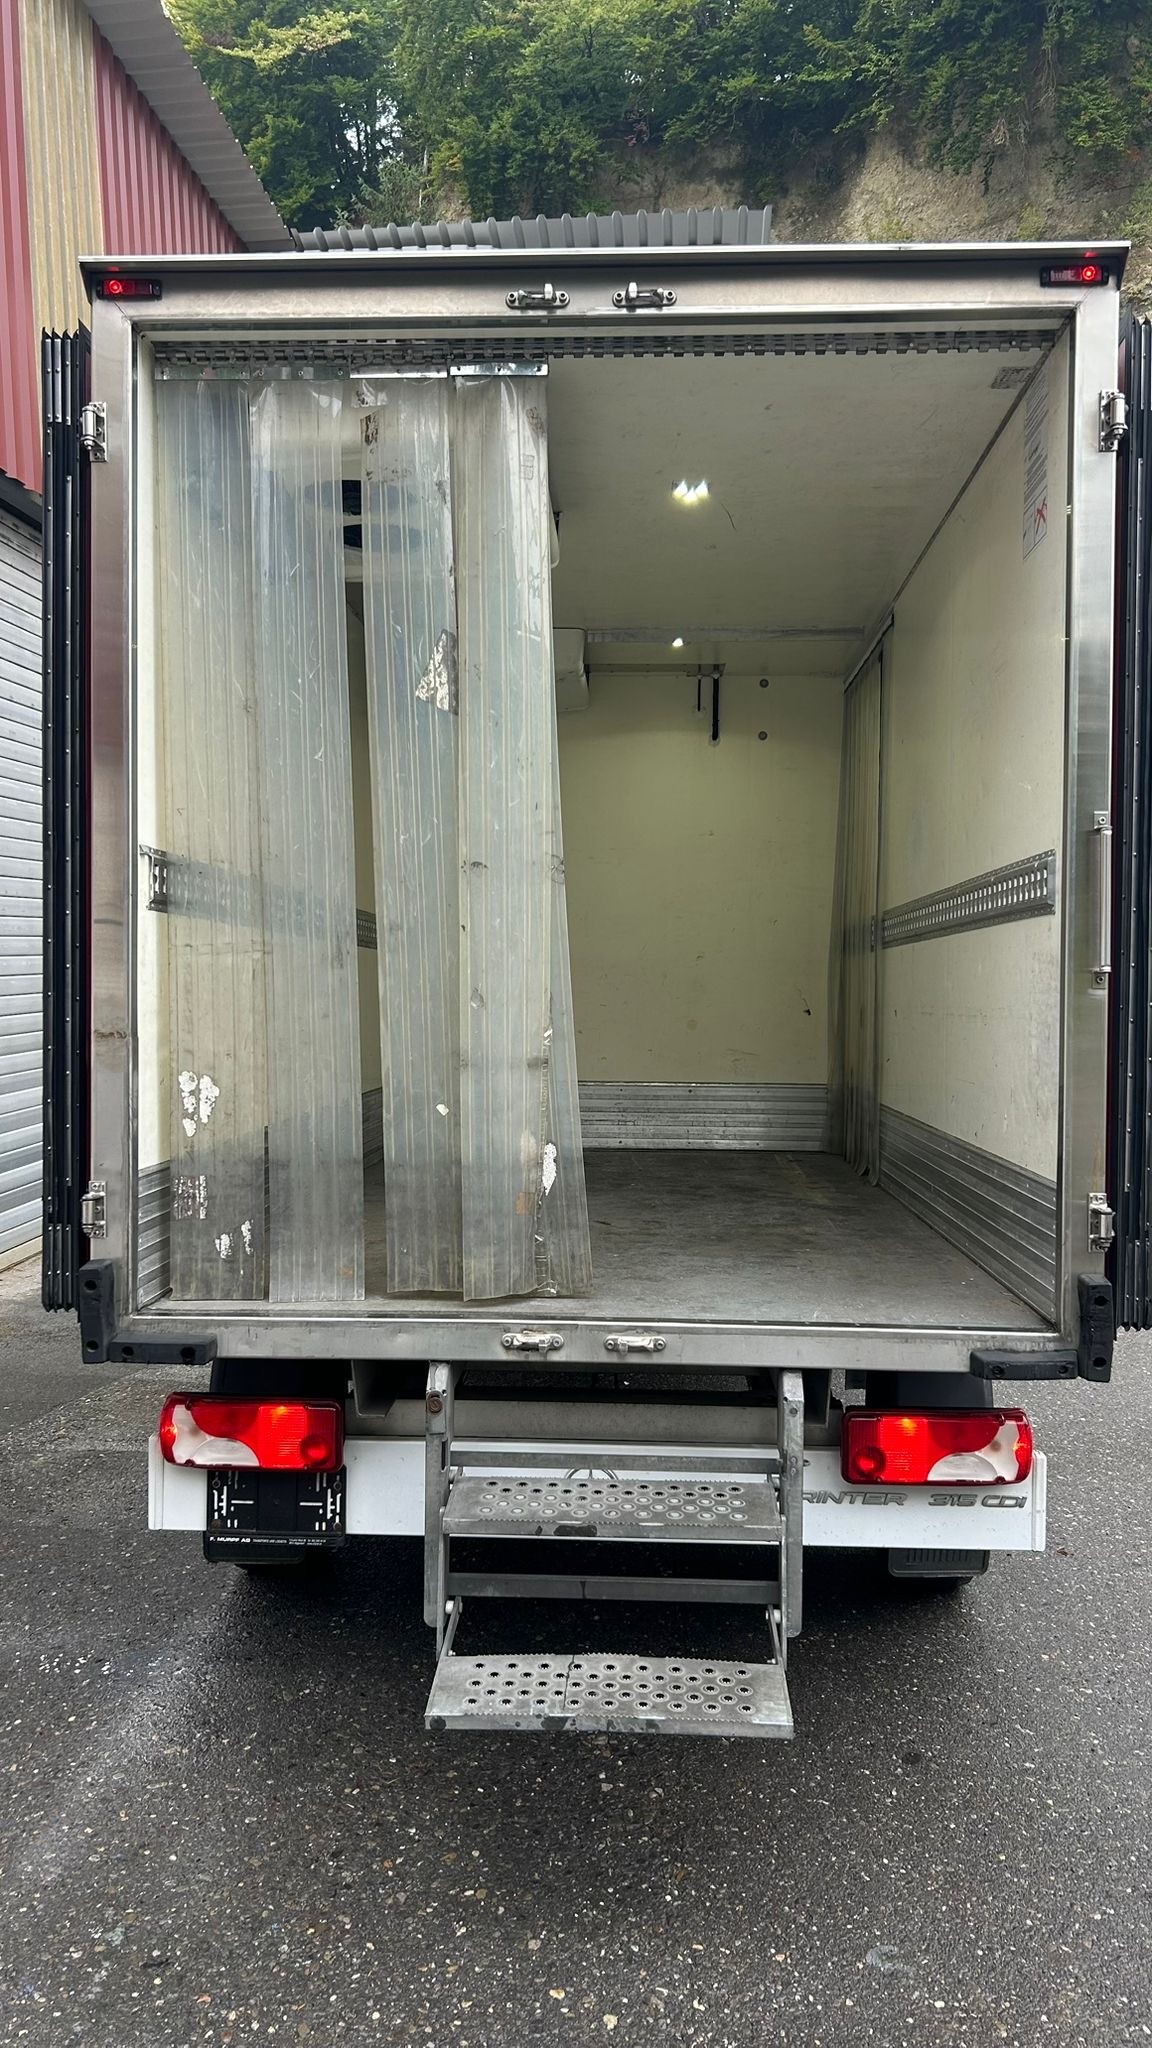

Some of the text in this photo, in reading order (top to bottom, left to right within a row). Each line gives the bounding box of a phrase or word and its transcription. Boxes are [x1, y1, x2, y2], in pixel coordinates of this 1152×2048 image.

[802, 1489, 1027, 1508] RINTER 315 CDI
